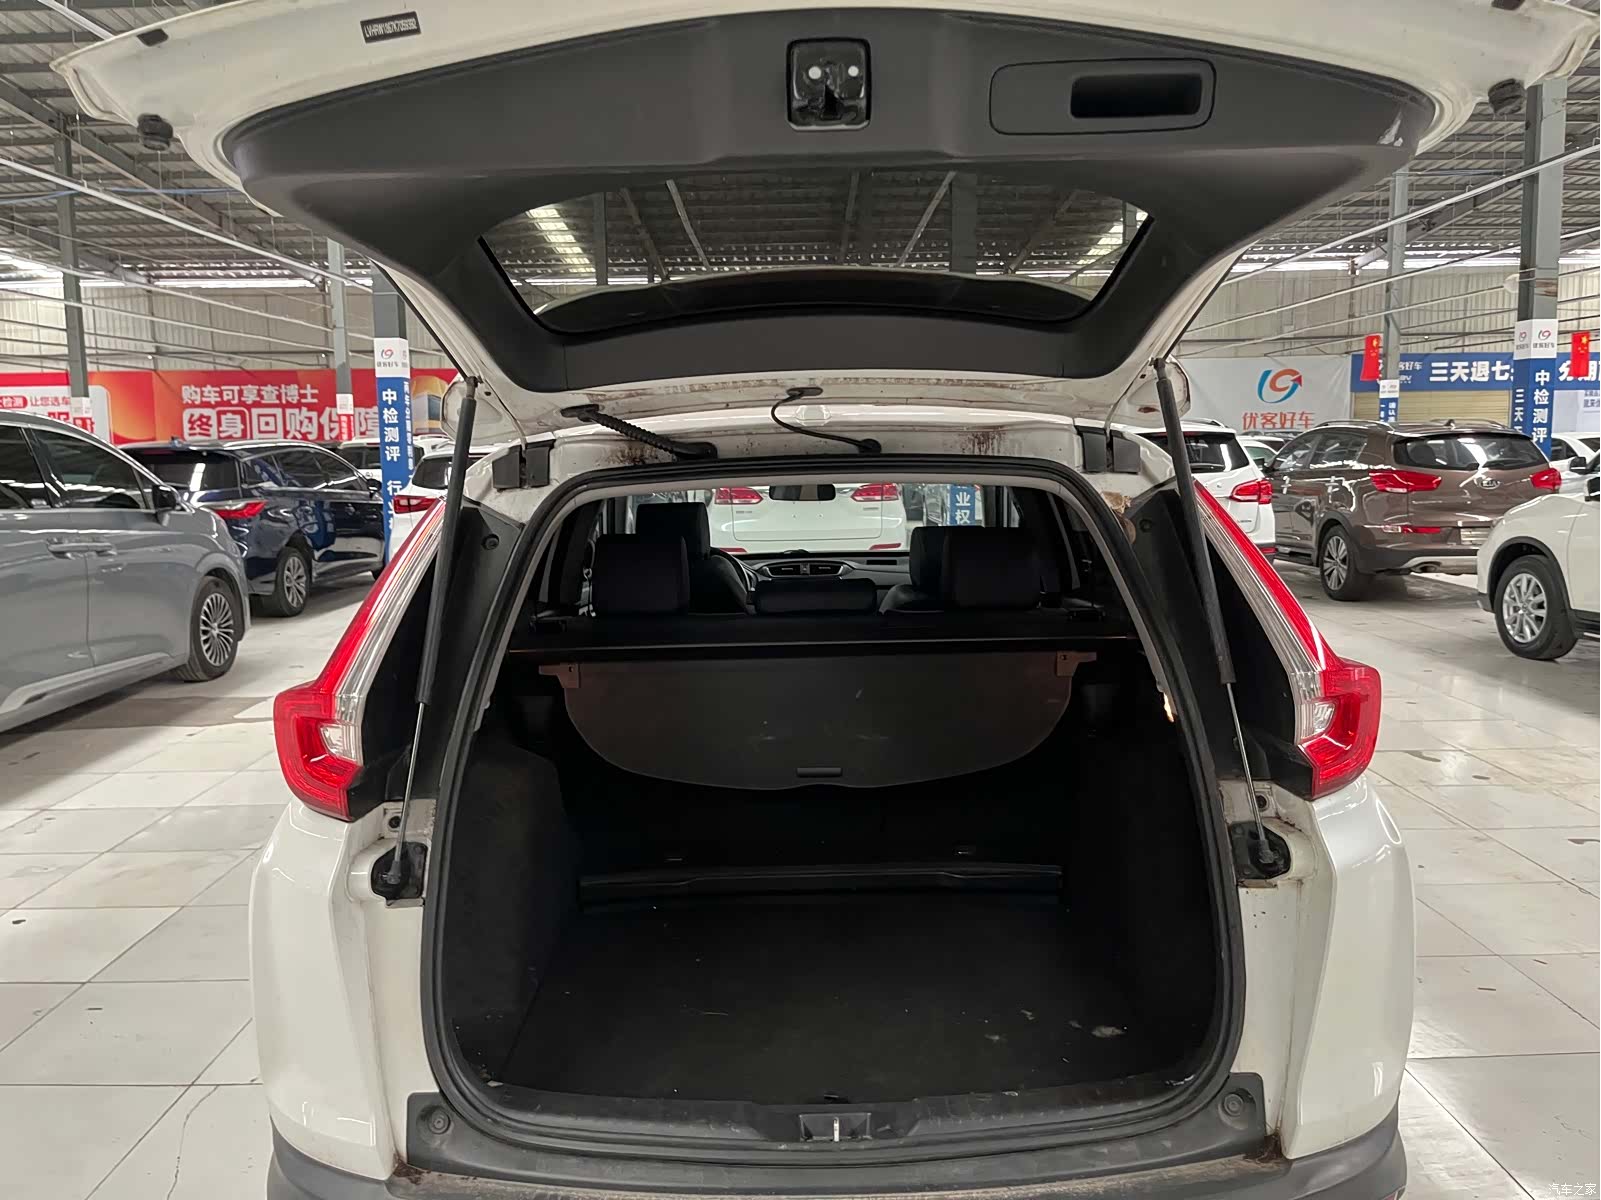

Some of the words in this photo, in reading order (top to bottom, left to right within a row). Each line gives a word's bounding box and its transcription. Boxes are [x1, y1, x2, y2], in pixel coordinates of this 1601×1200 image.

[1429, 360, 1514, 382] 三天退七
[181, 384, 319, 405] 购车可享查博士
[1531, 369, 1551, 444] 中检测评
[382, 388, 401, 462] 中检测评
[1242, 411, 1315, 430] 优客好车
[955, 486, 971, 525] 业权
